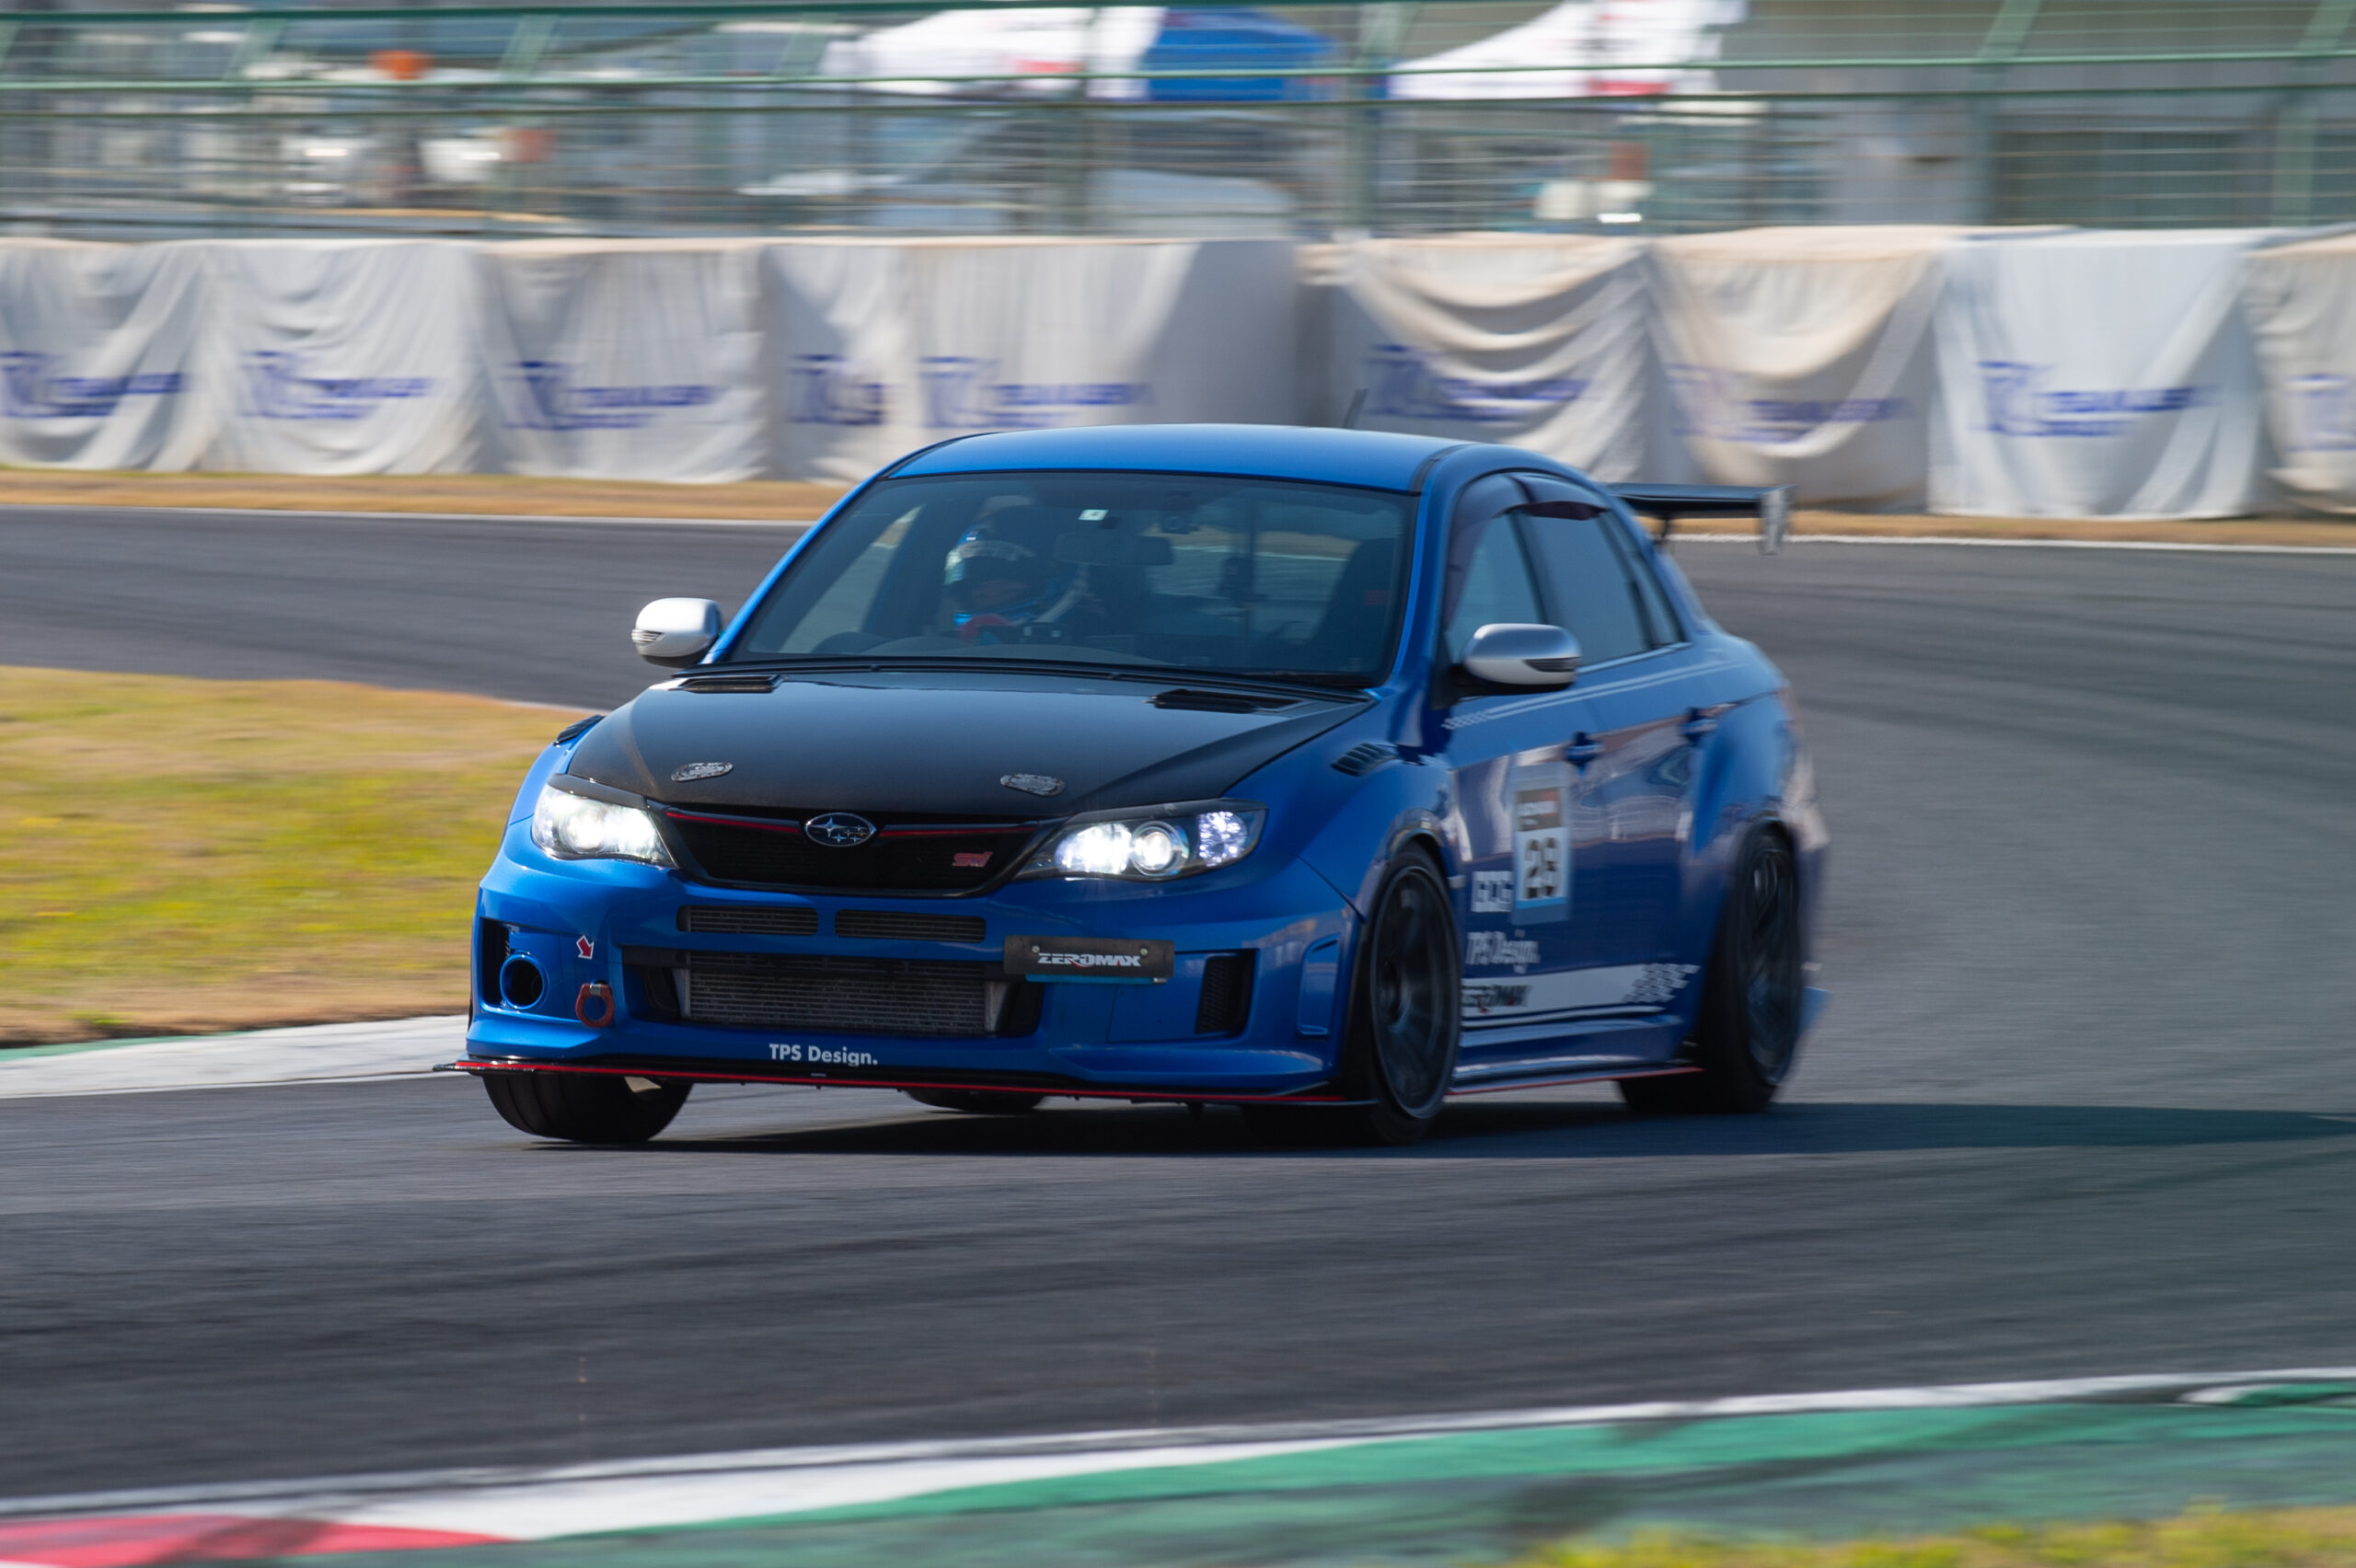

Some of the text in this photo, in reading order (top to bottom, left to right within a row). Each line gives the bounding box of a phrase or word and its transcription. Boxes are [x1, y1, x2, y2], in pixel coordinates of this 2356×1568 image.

[1037, 952, 1141, 969] ZEROMAX
[768, 1043, 878, 1066] TPS Design.
